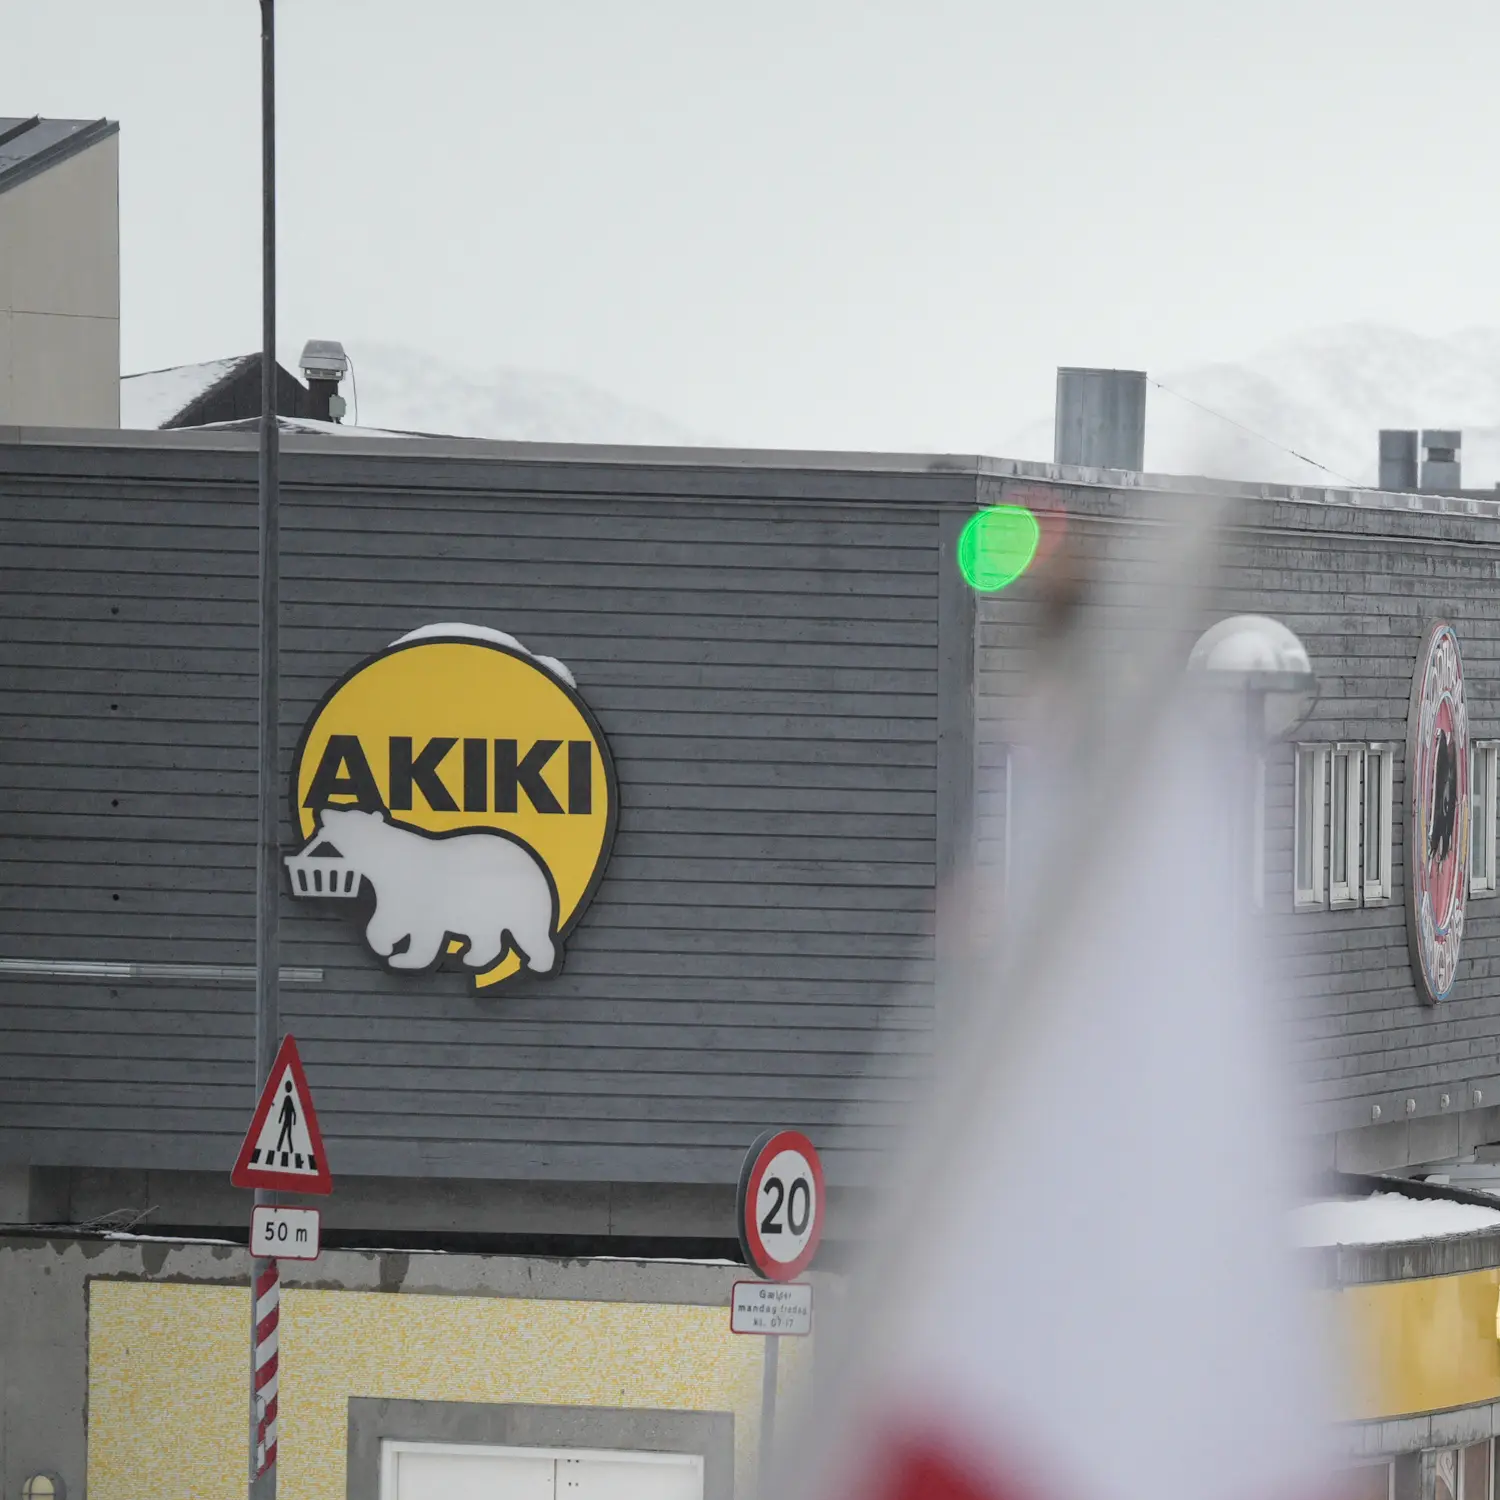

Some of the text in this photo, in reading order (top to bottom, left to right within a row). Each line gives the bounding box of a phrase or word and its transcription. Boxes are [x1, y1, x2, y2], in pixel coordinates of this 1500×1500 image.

[303, 735, 593, 815] AKIKI
[264, 1221, 309, 1243] 50 m
[760, 1177, 810, 1237] 20
